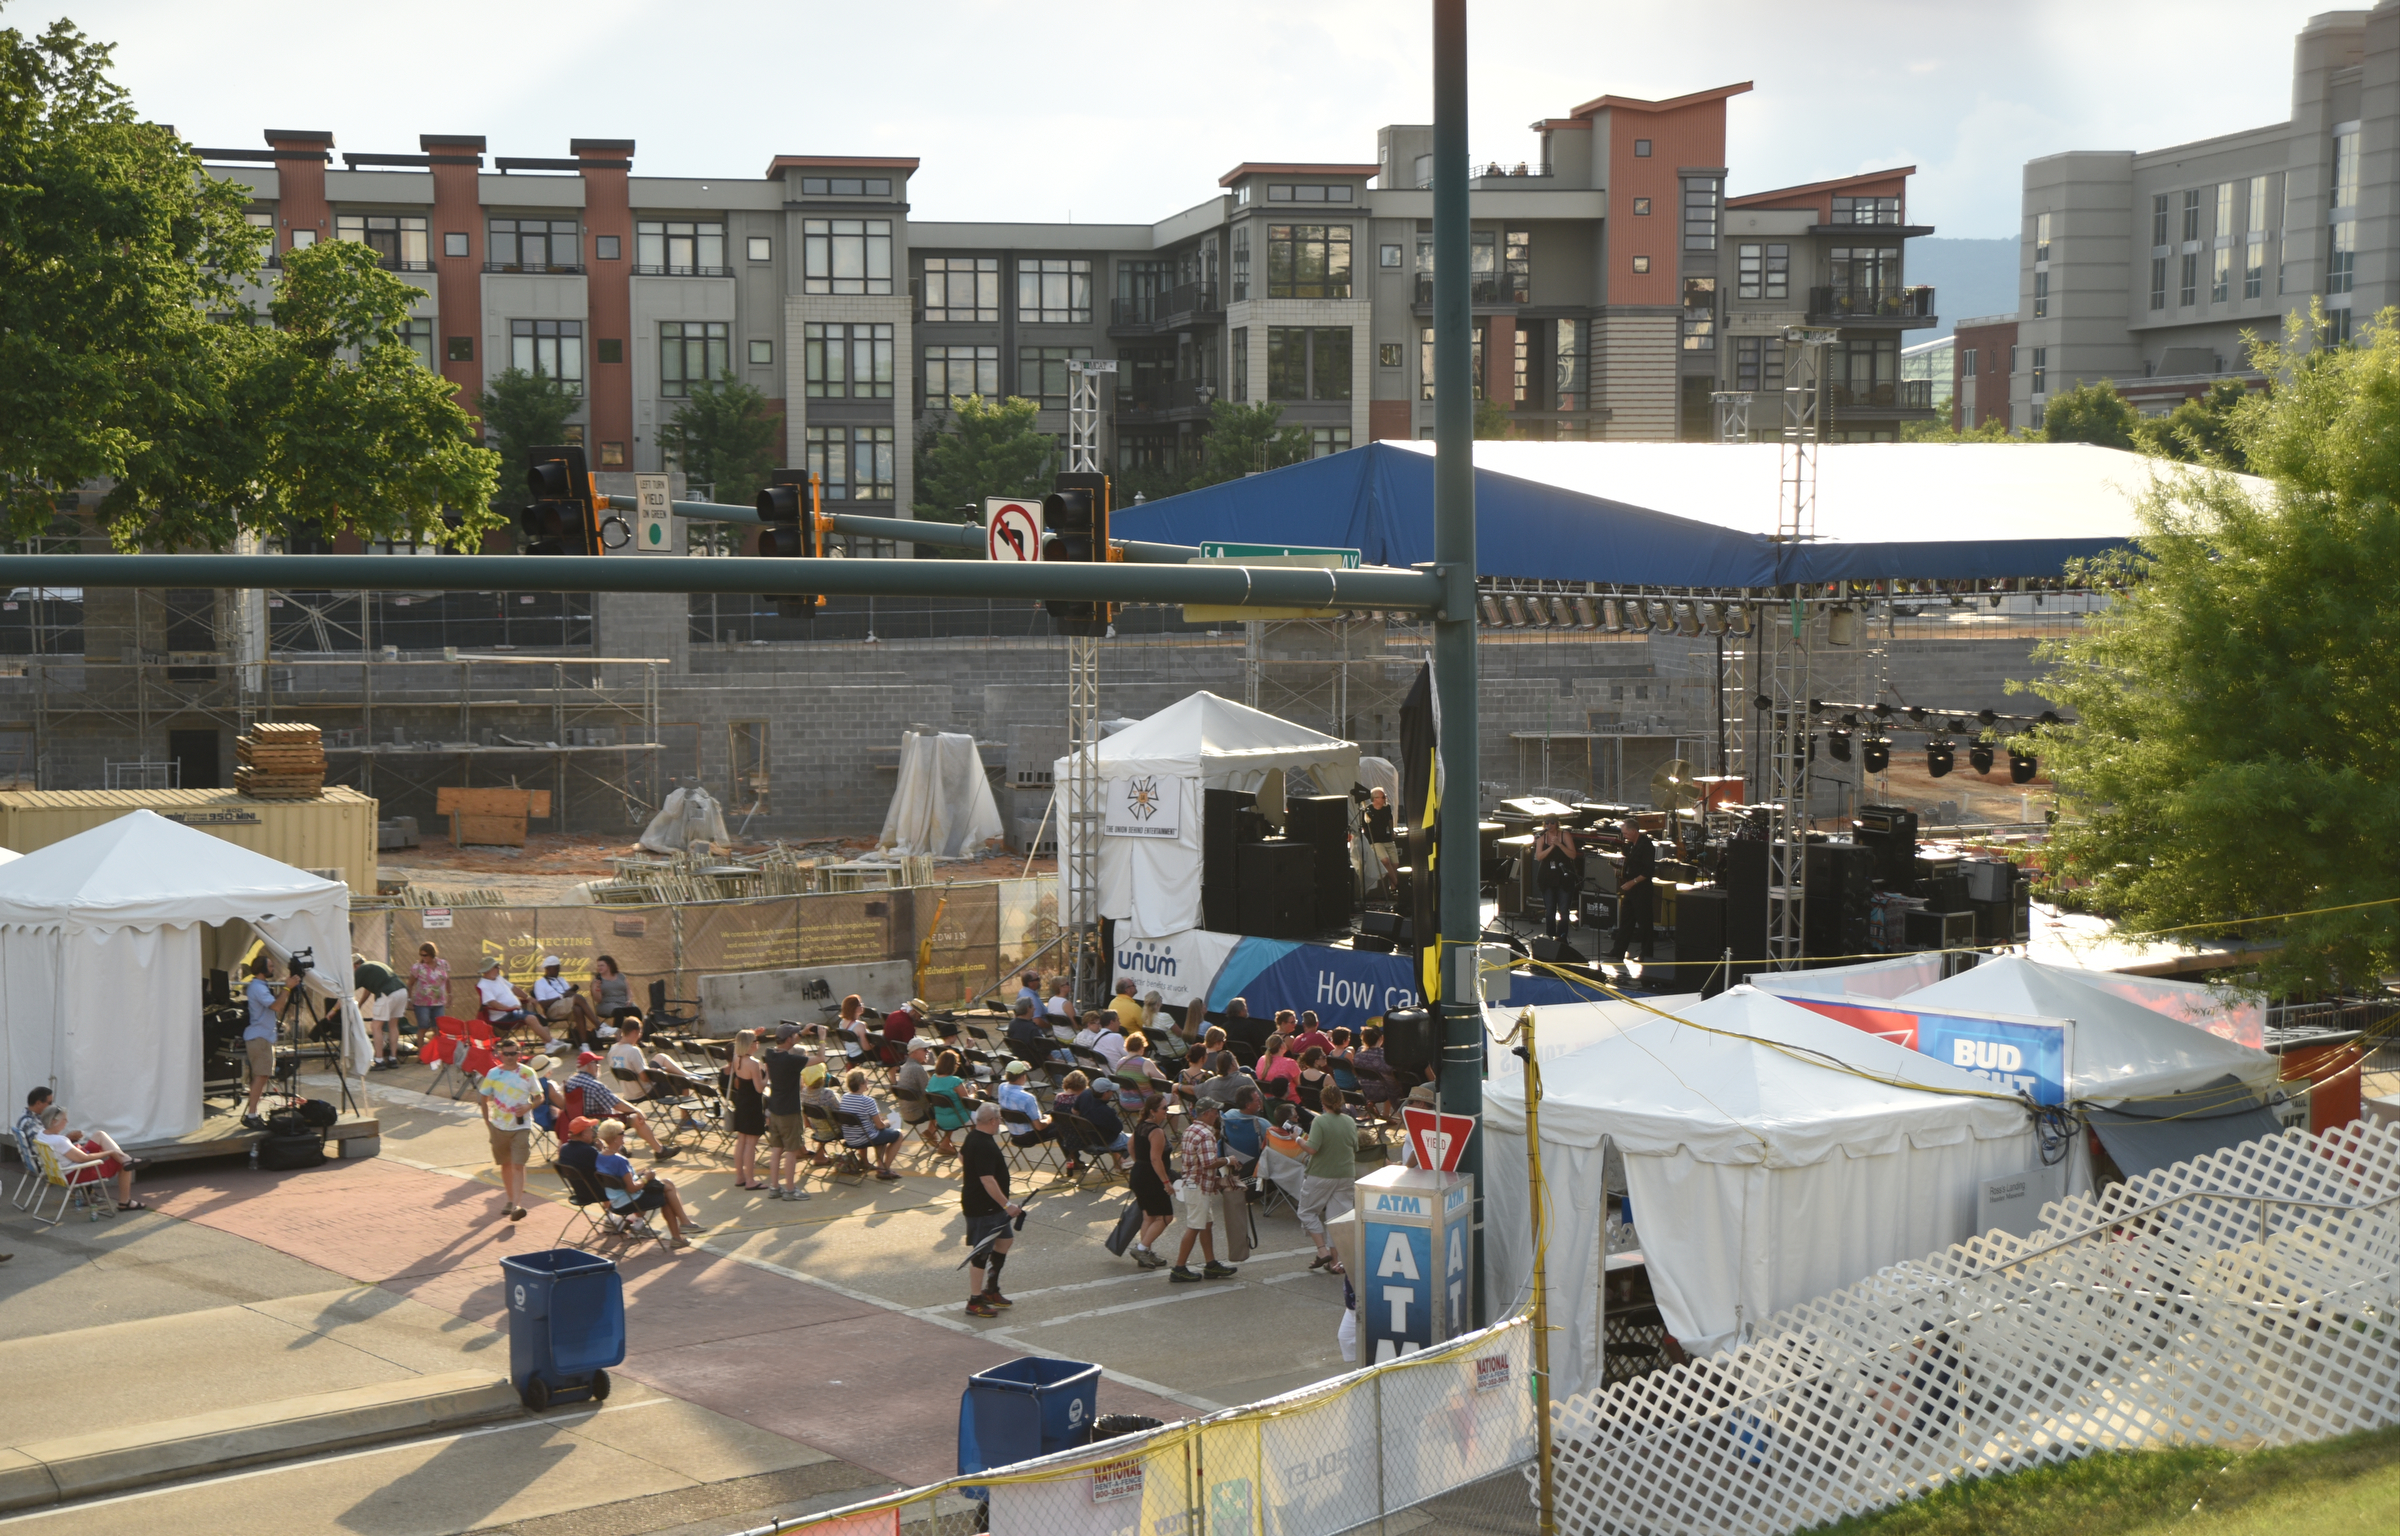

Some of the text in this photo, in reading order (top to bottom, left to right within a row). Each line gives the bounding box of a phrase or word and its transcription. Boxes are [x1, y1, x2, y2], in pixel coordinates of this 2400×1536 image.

[640, 480, 665, 489] LEFT TURN
[643, 493, 664, 505] YIELD
[642, 509, 666, 518] ON GREEN
[209, 812, 255, 820] 950-MINI
[1115, 826, 1127, 834] UNION
[1128, 826, 1143, 834] BEHIND
[1144, 827, 1176, 836] ENTERTAINMENT
[508, 937, 593, 947] CONNECTING
[931, 932, 967, 942] EDWIN
[509, 946, 592, 976] Sping
[1118, 942, 1177, 977] unum
[1147, 979, 1166, 990] benefits
[1173, 984, 1189, 993] work.
[1317, 970, 1374, 1010] How
[1953, 1038, 2022, 1072] BUD
[1990, 1181, 2025, 1195] Ross's Landing
[1376, 1194, 1421, 1213] ATM
[1447, 1187, 1464, 1212] ATM
[1476, 1354, 1508, 1375] NATIONAL
[1094, 1458, 1142, 1484] NATIONAL
[1095, 1475, 1142, 1491] RENT-A-FENCE
[1095, 1482, 1142, 1499] 800-352-5675
